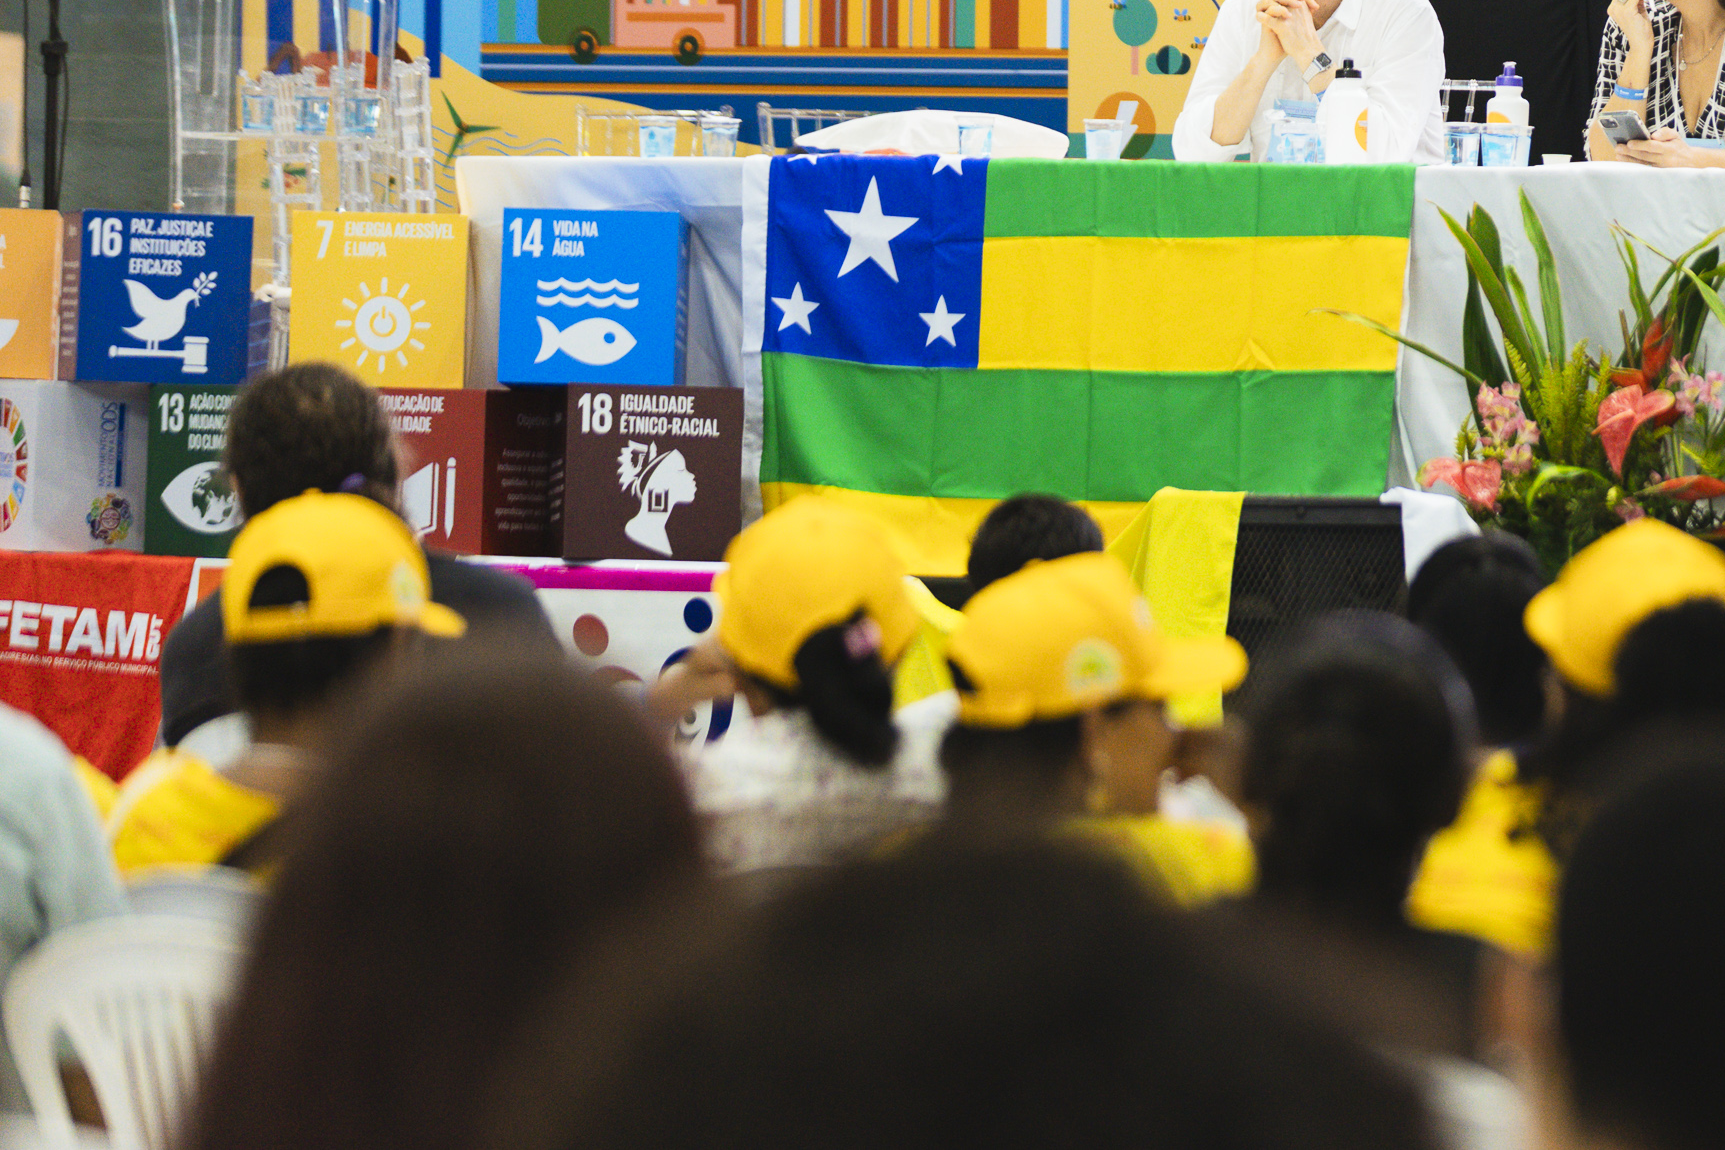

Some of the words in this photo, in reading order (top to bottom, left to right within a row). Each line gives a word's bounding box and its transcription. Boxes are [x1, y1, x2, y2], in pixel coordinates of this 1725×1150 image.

[88, 217, 123, 258] 16
[157, 219, 205, 238] JUSTIÇA
[205, 221, 214, 238] E
[344, 221, 393, 238] ENERGIA
[393, 221, 455, 239] ACESSÍVEL
[509, 218, 544, 258] 14
[553, 220, 580, 237] VIDA
[581, 221, 599, 237] NA
[129, 237, 206, 257] INSTITUIÇÕES
[316, 220, 333, 260] 7
[344, 241, 352, 256] E
[352, 241, 387, 257] LIMPA
[552, 237, 585, 257] ÁGUA
[128, 258, 183, 277] EFICAZES
[190, 392, 214, 411] AÇÃO
[431, 396, 445, 413] DE
[620, 394, 695, 414] IGUALDADE
[159, 393, 185, 433] 13
[577, 392, 613, 434] 18
[390, 415, 433, 433] ALIDADE
[620, 414, 720, 436] ÉTNICO-RACIAL
[188, 433, 202, 450] DO
